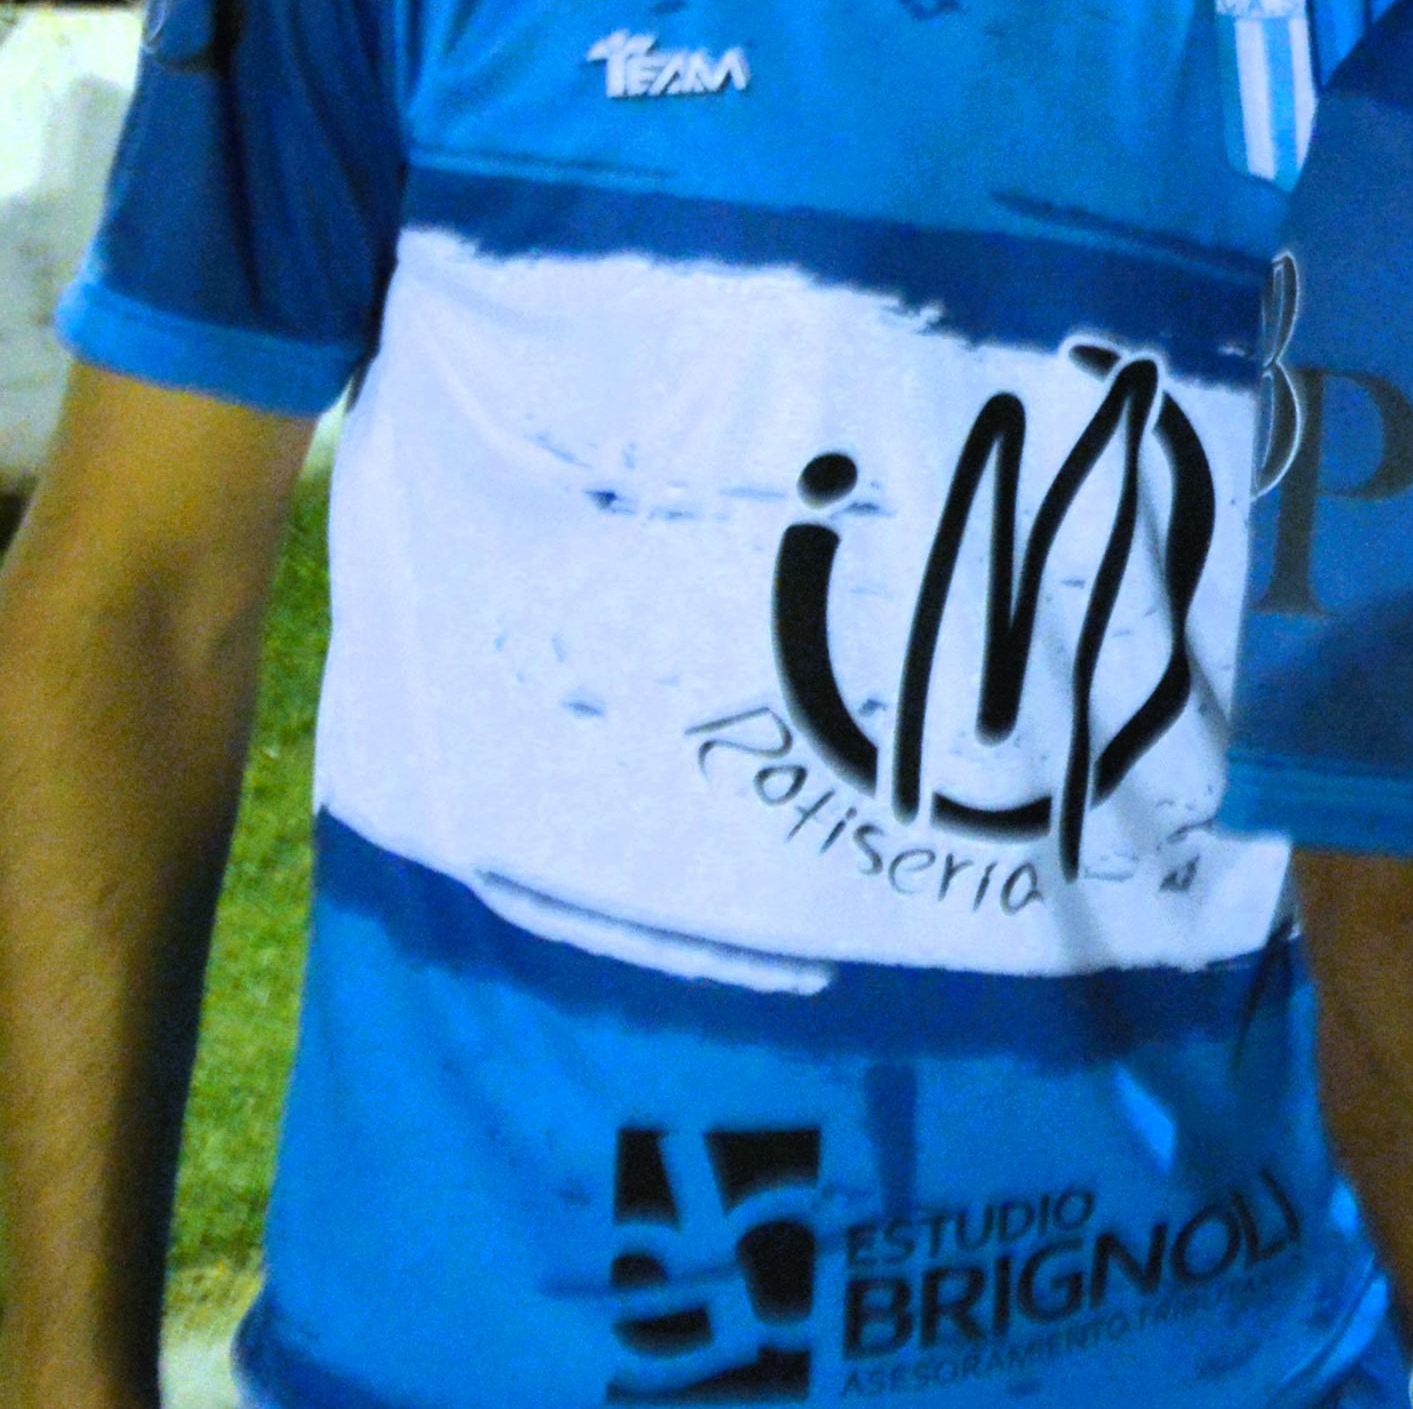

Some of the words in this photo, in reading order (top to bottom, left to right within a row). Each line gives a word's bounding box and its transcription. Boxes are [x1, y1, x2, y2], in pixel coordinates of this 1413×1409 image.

[587, 28, 750, 98] TEAM
[684, 704, 1049, 915] Rotiseria
[842, 1167, 1302, 1362] BRIGNOLI
[845, 1182, 1095, 1270] ESTUDIO
[840, 1310, 1130, 1398] ASESORAMIENTO
